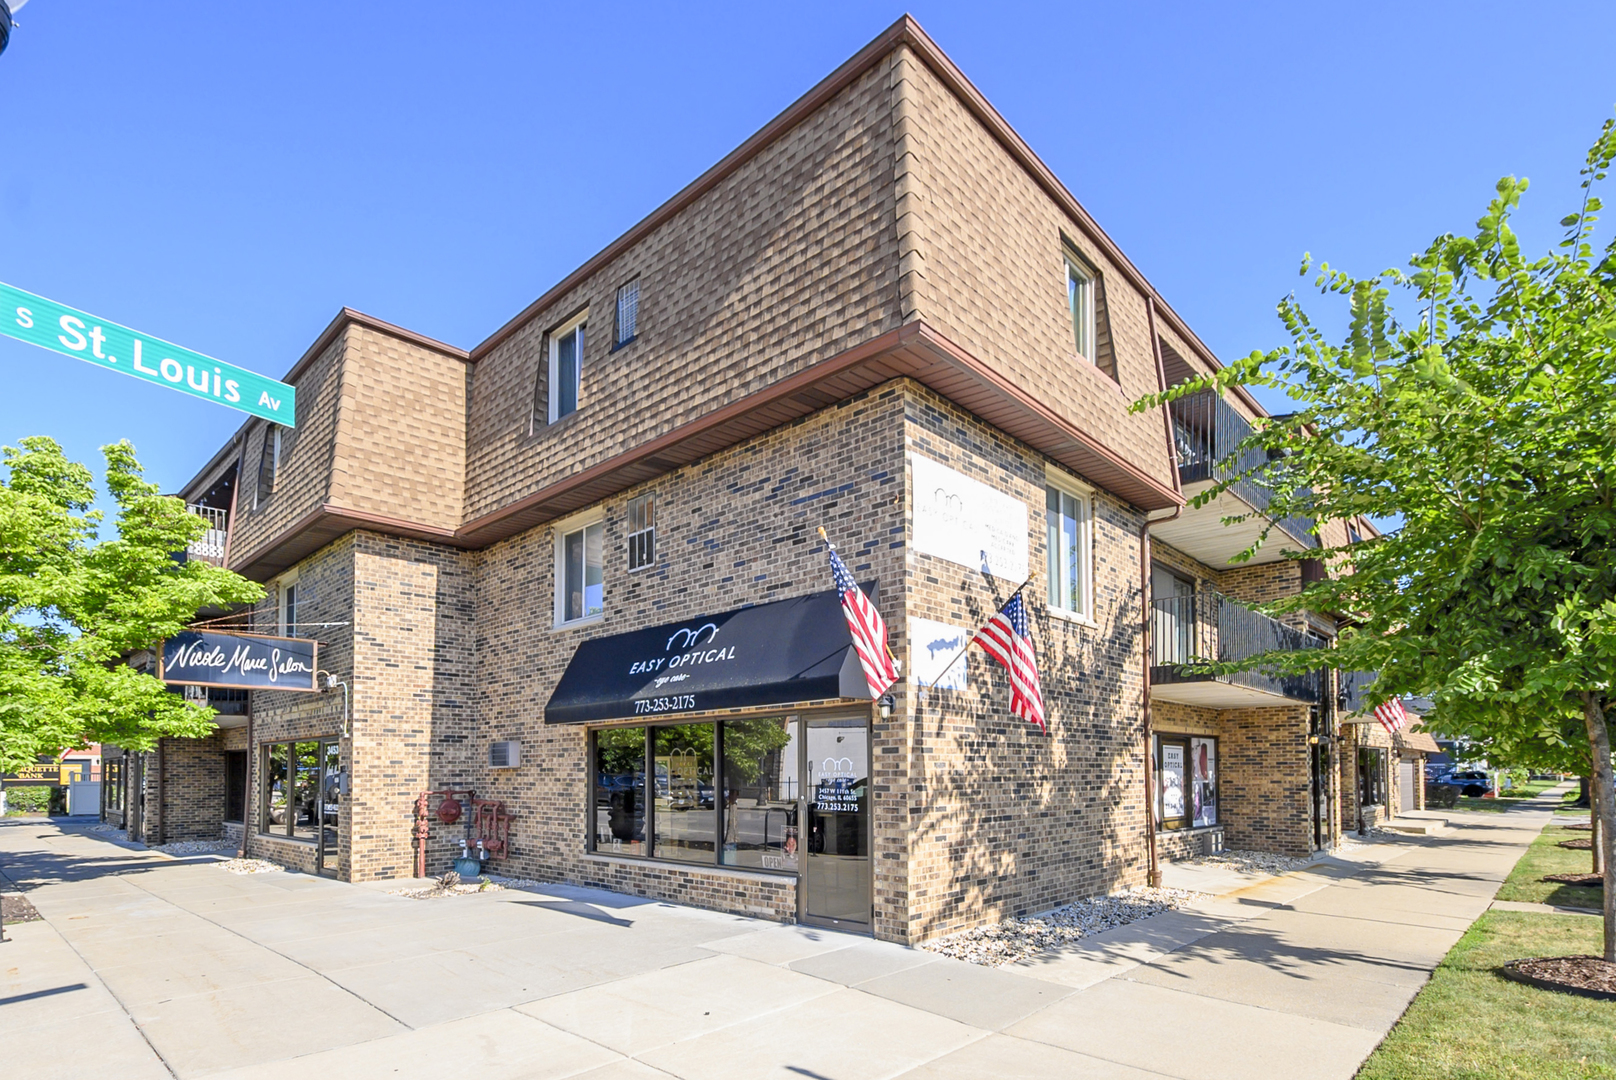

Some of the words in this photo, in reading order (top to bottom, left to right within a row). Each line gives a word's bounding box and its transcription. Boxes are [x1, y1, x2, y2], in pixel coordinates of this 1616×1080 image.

[15, 307, 34, 328] S
[57, 315, 117, 363] St.
[133, 339, 241, 403] Louis
[258, 391, 281, 411] Av
[165, 639, 226, 672] Nicole
[222, 645, 267, 676] Marie
[269, 648, 313, 682] Salon
[629, 658, 665, 674] EASY
[668, 646, 735, 668] OPTICAL
[634, 694, 695, 713] 773-253-2175
[764, 856, 782, 869] OPEN
